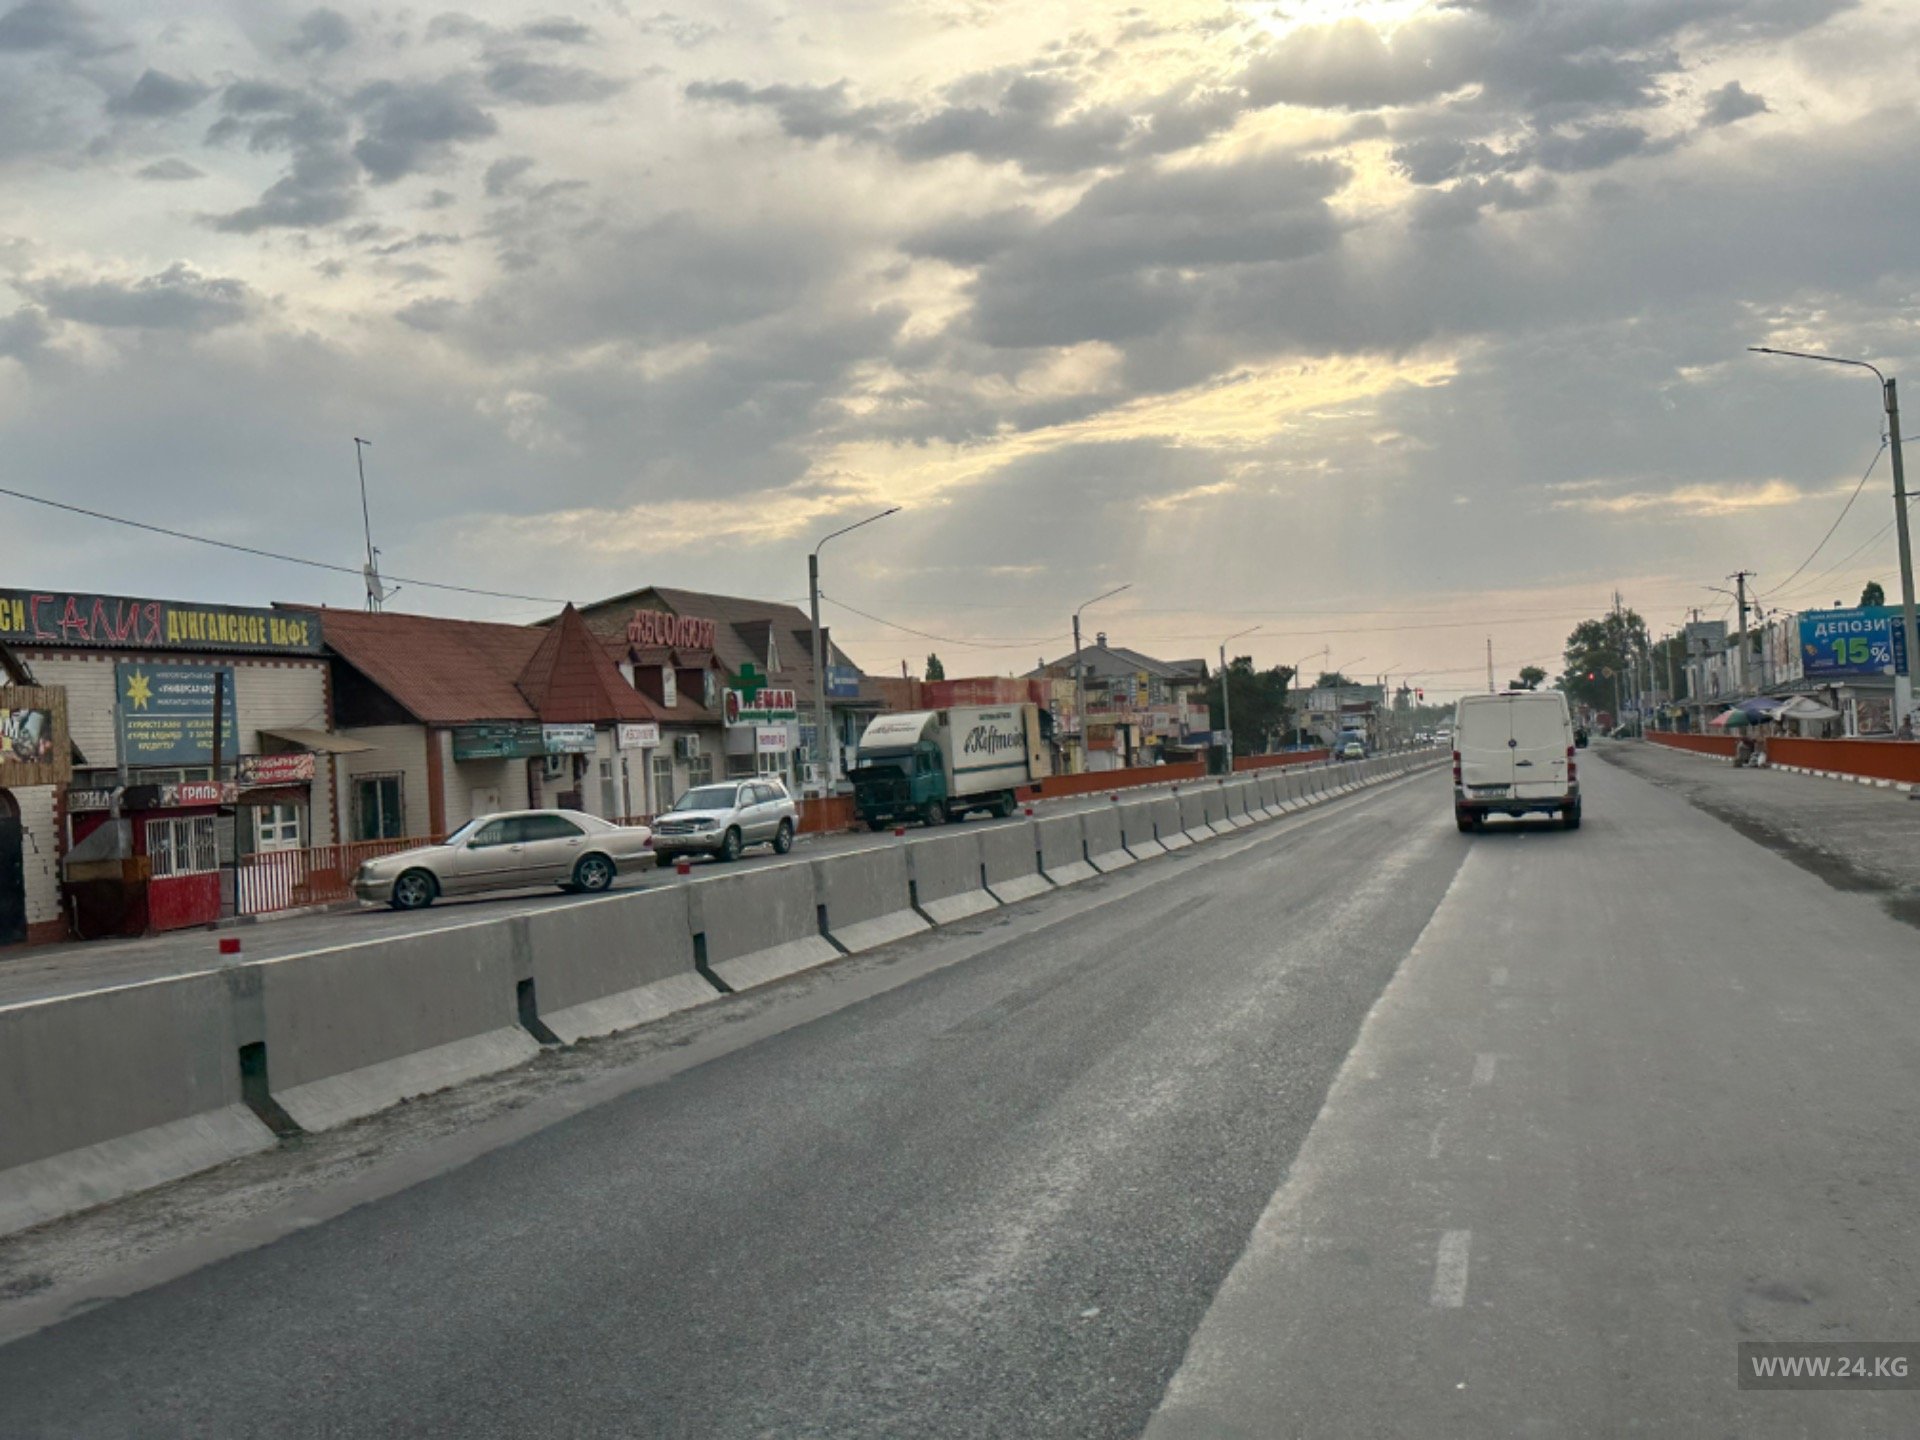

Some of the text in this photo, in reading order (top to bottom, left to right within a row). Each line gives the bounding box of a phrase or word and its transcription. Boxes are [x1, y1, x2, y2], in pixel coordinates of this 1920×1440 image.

[30, 594, 163, 644] САЛИЯ
[167, 609, 267, 644] ДУНГАНСКОЕ
[270, 617, 309, 647] КАФЕ
[1815, 618, 1891, 638] ДЕПОЗИ
[744, 690, 793, 709] ЕМАН
[182, 784, 218, 800] ГРИЛЬ
